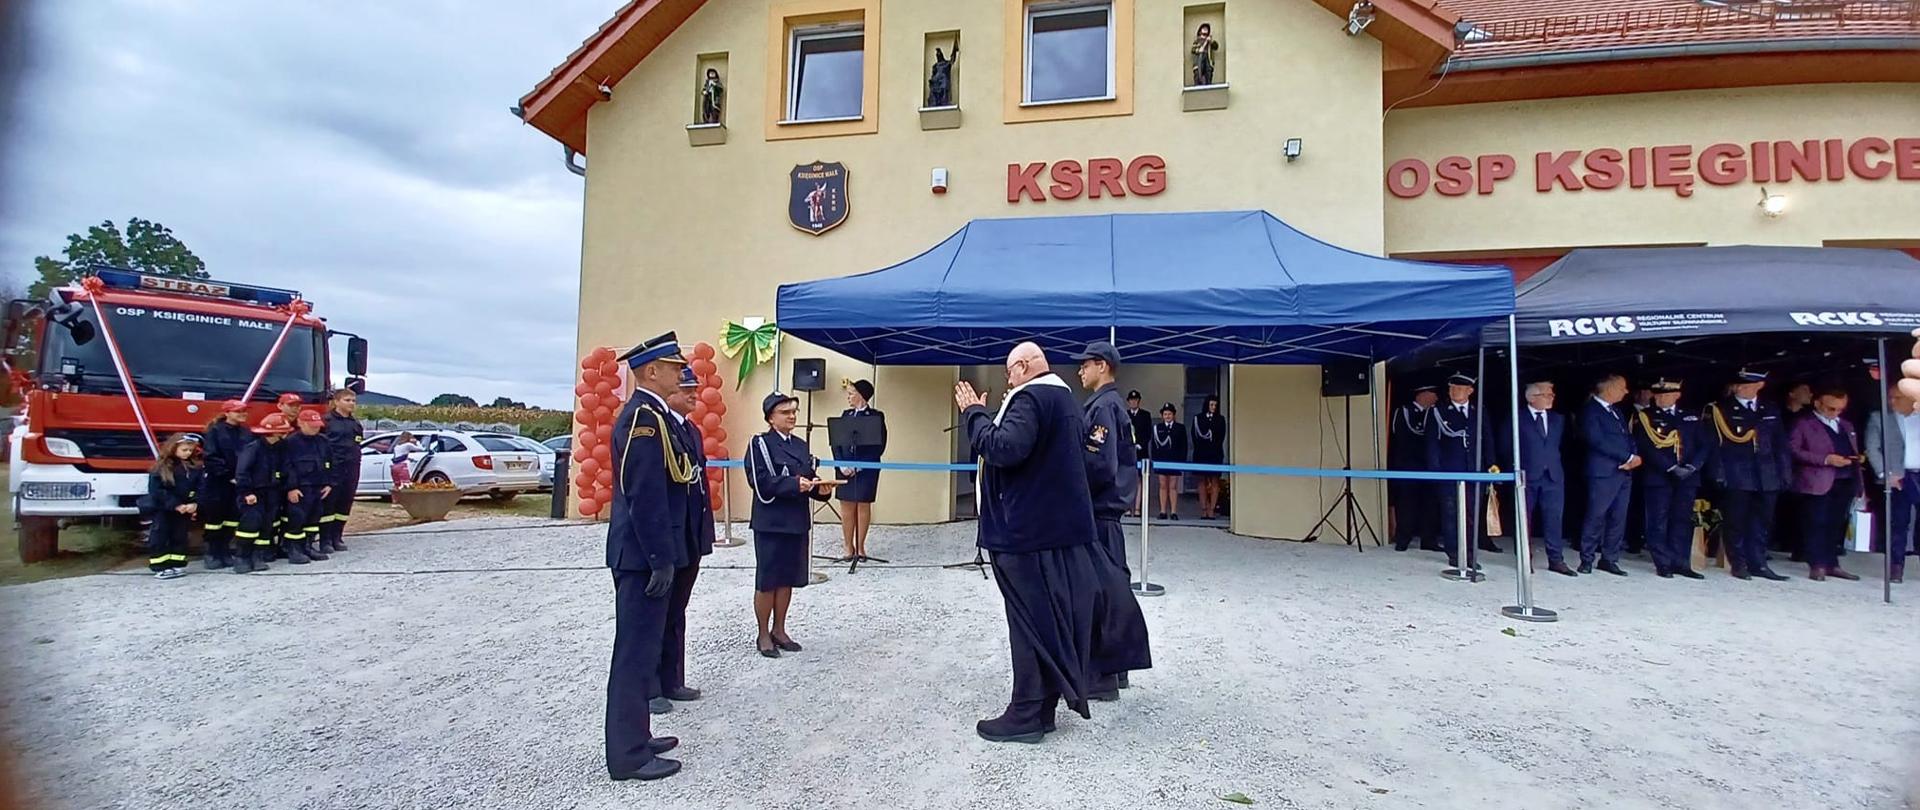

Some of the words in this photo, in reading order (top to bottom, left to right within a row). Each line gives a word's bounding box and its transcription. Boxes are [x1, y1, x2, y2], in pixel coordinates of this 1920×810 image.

[1007, 155, 1167, 203] KSRG
[1386, 154, 1516, 199] OSP
[1535, 136, 1920, 198] KSIĘGINICE
[116, 307, 146, 317] OSP
[153, 311, 231, 326] KSIĘGINICE
[238, 319, 273, 331] MAŁE
[1548, 315, 1636, 337] RCKS
[1789, 311, 1883, 326] RCKS
